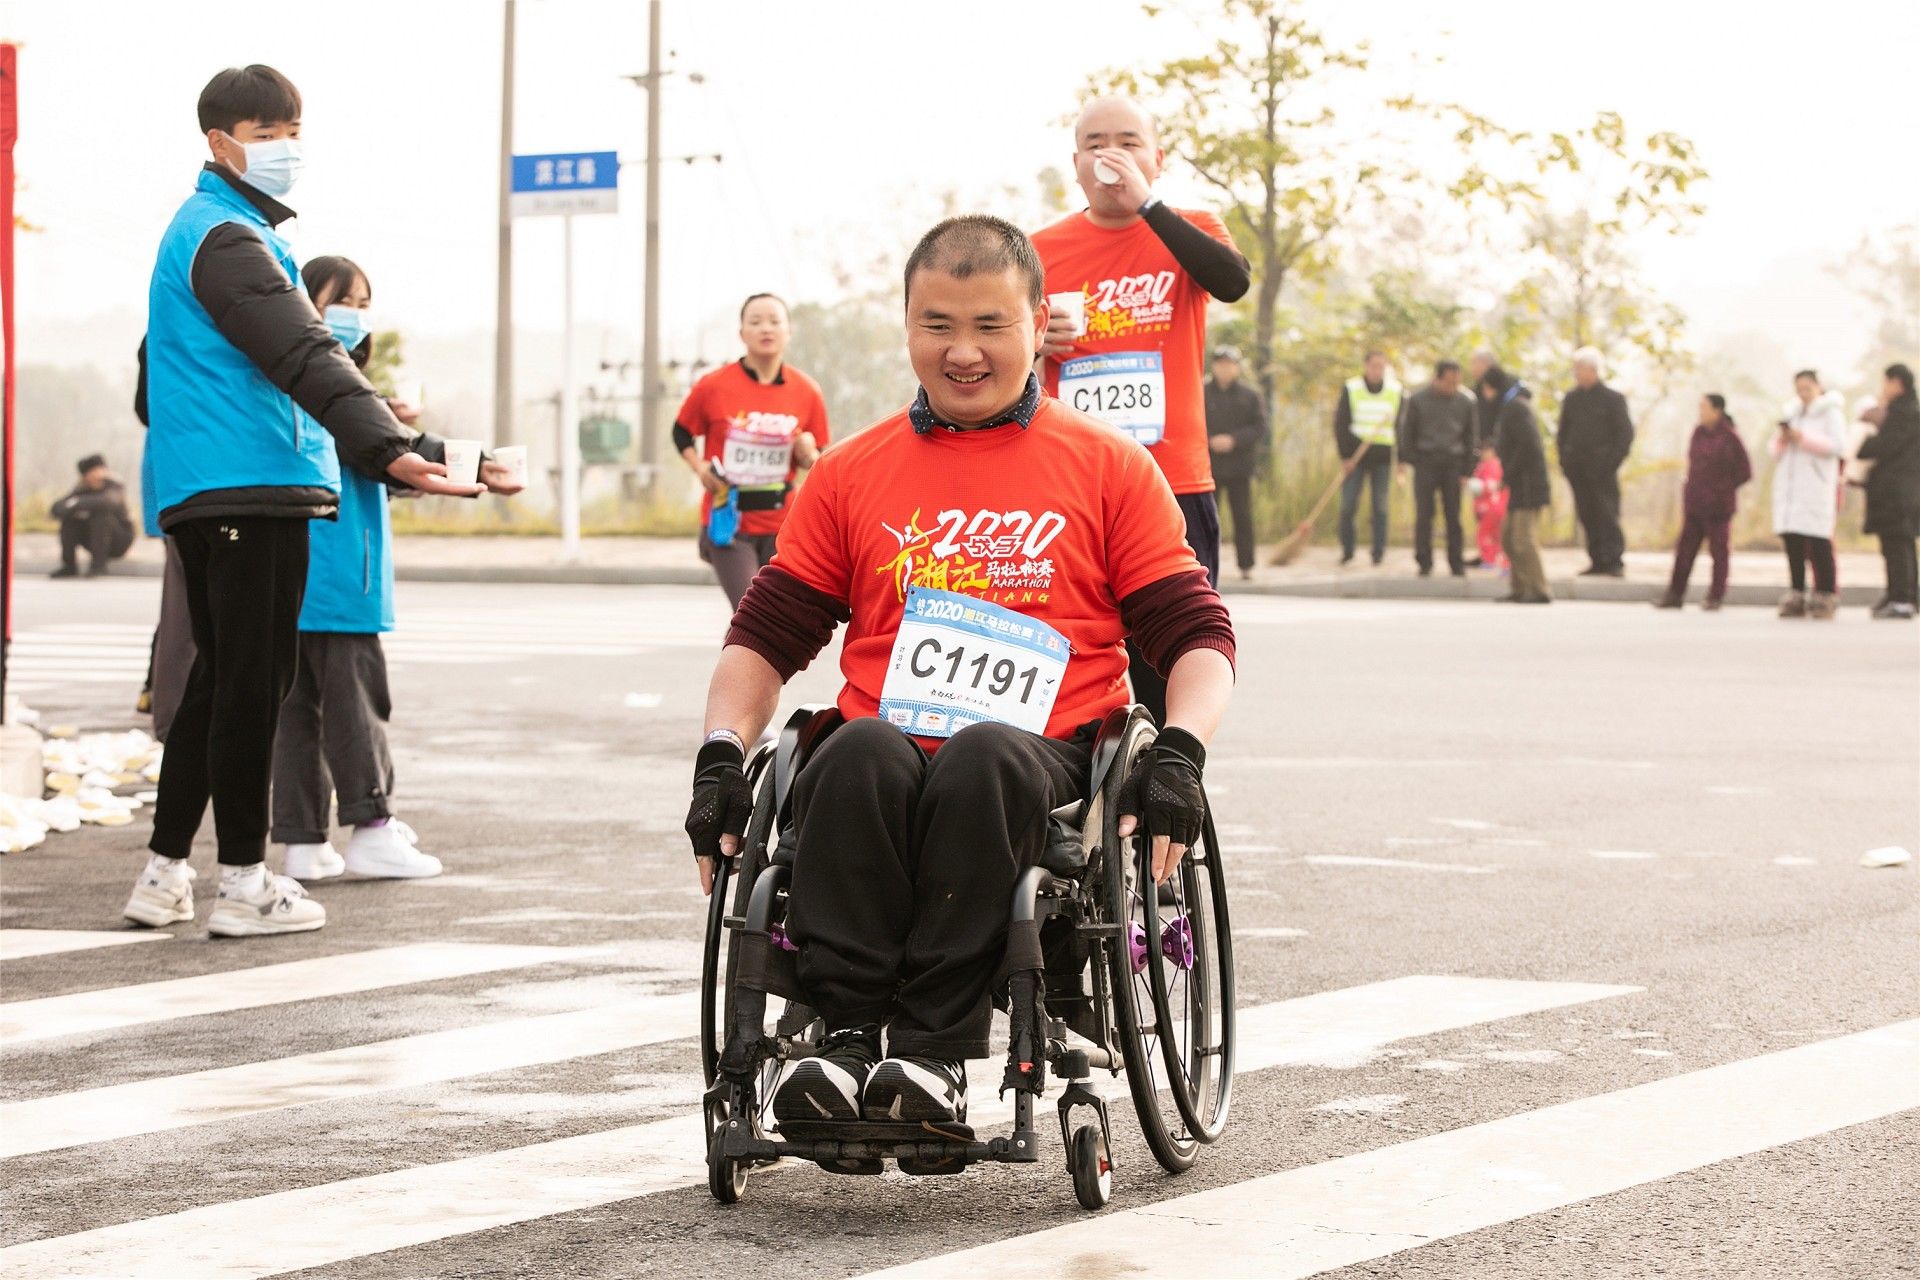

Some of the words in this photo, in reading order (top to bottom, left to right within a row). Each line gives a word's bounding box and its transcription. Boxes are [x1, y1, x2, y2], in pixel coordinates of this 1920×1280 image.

[1074, 383, 1152, 412] C1238
[931, 509, 1067, 559] 2020
[912, 553, 992, 591] 湘江
[986, 558, 1056, 578] 马拉松赛
[991, 578, 1052, 588] MARATHON
[910, 638, 1040, 704] C1191
